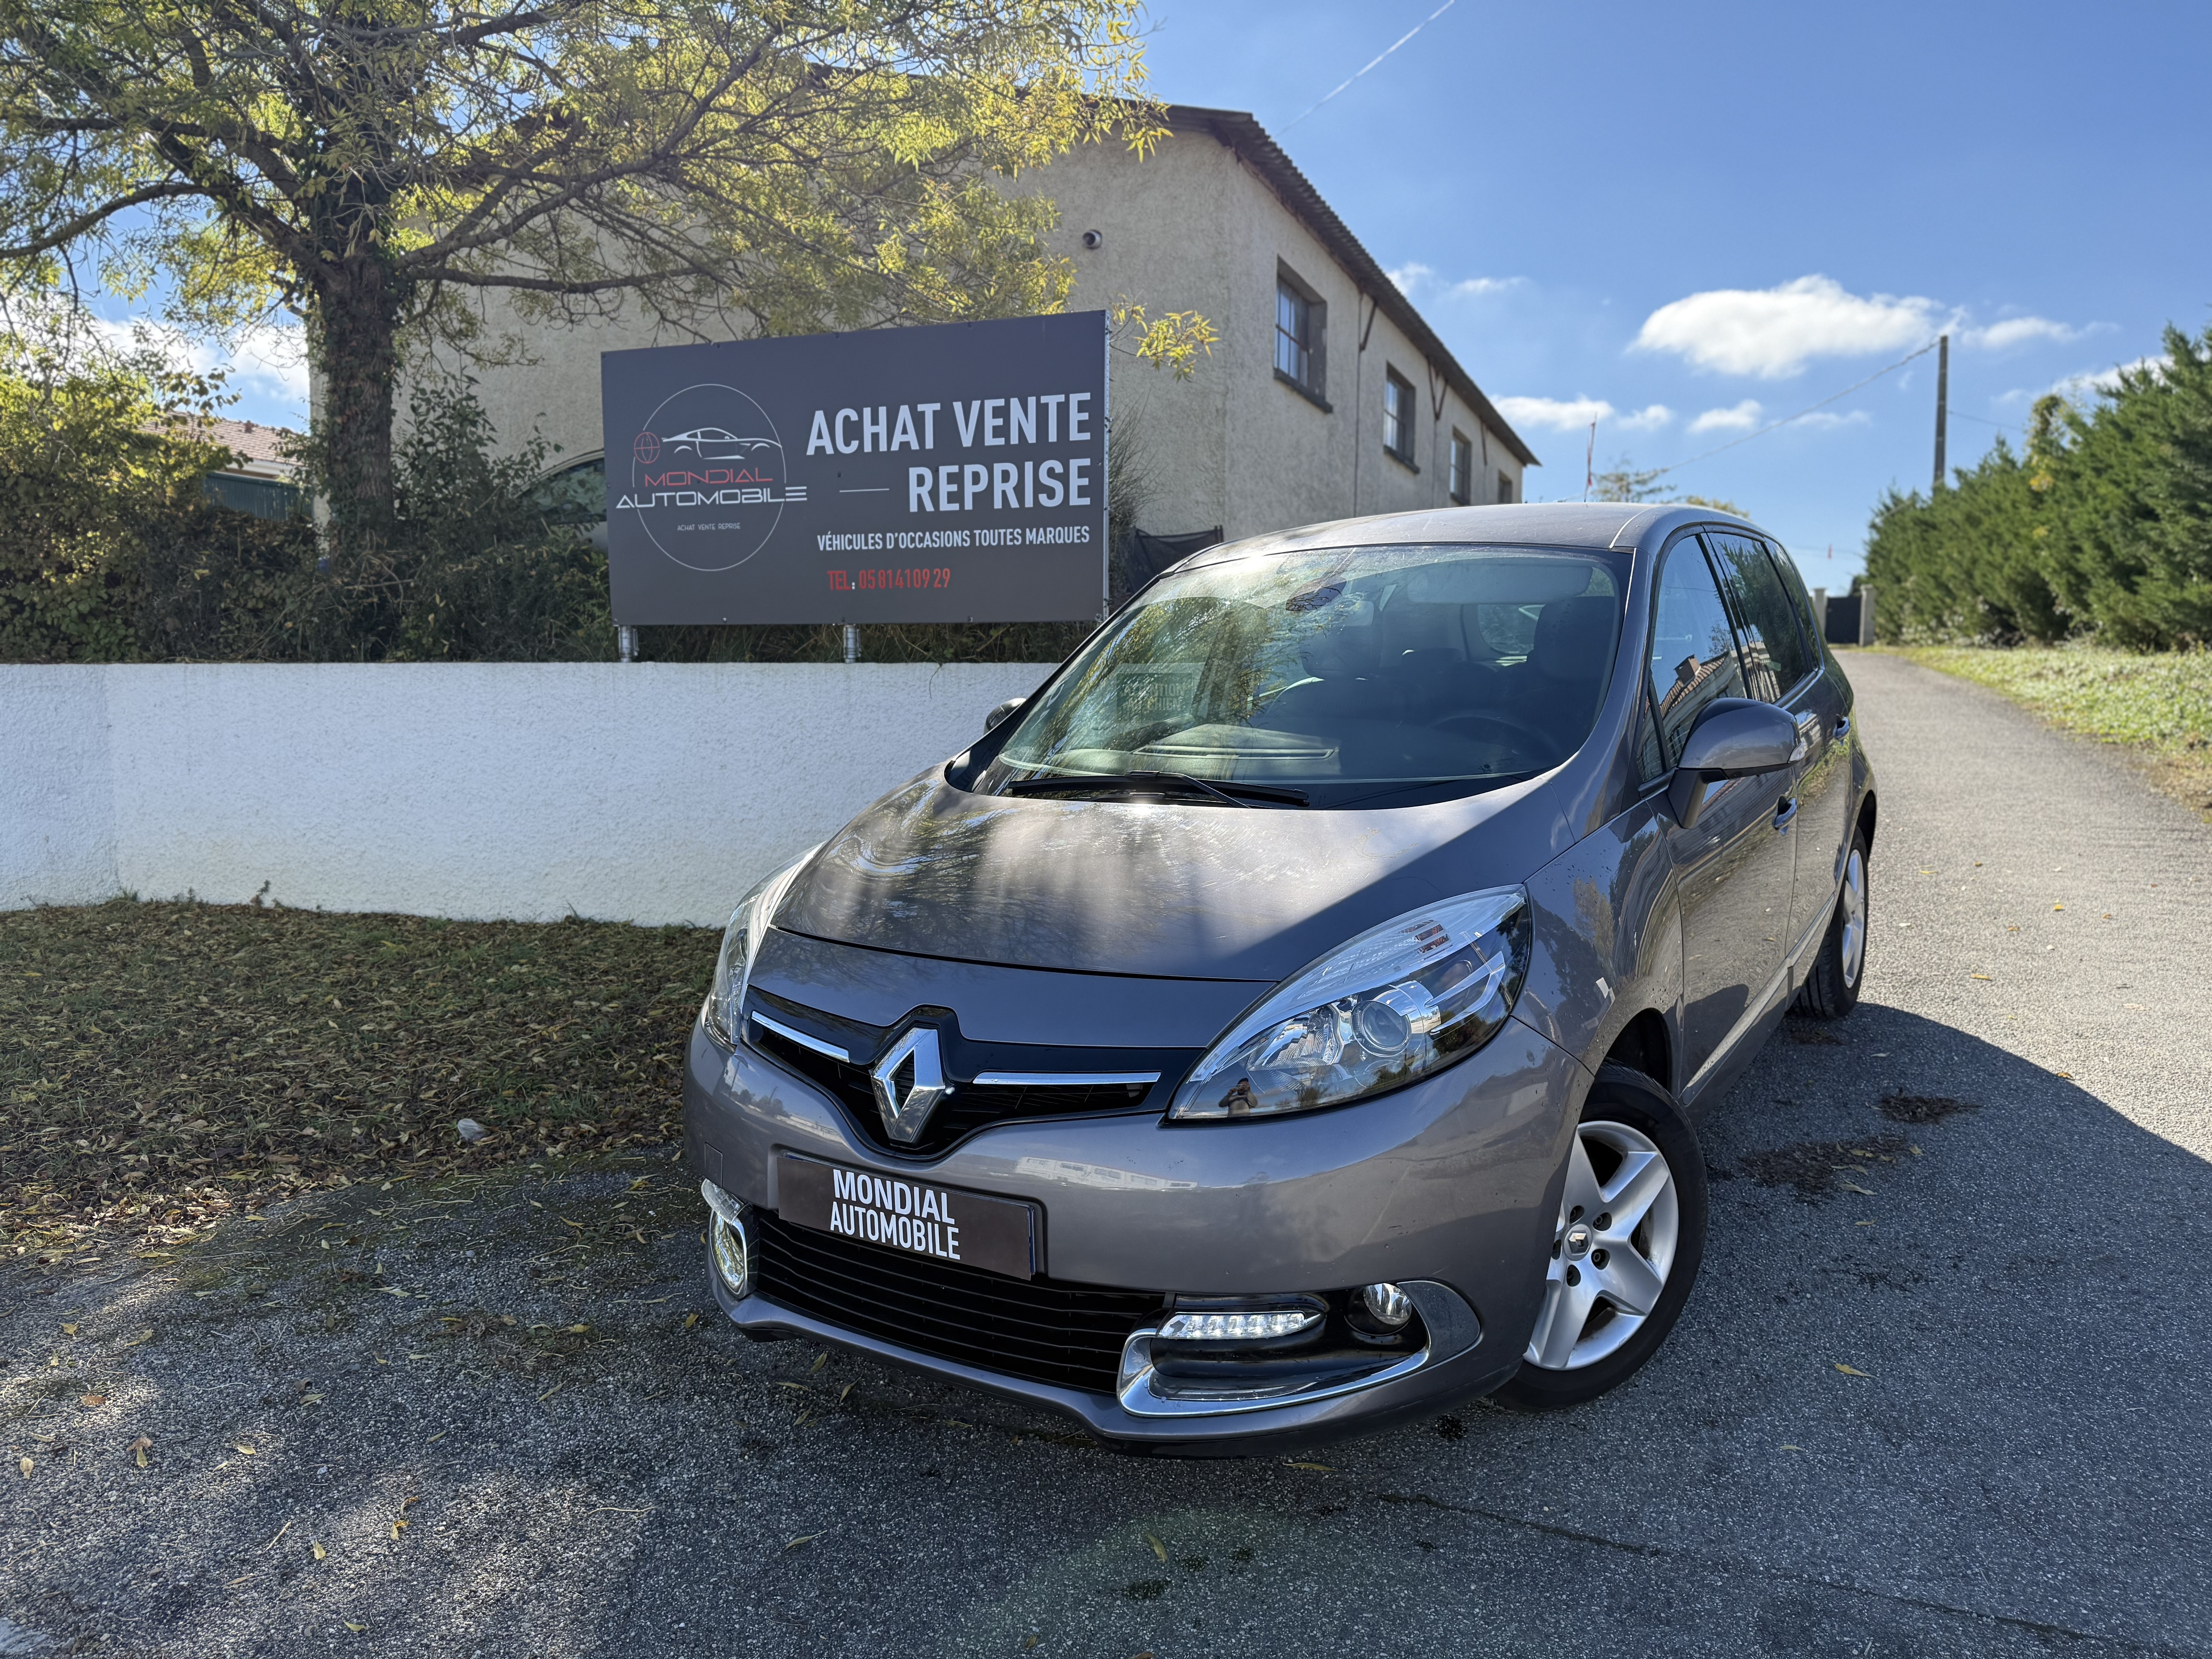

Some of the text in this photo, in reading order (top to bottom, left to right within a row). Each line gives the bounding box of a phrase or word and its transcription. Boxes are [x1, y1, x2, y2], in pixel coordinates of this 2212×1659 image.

[806, 392, 1091, 455] ACHAT VENTE
[616, 486, 807, 508] AUTOMOBILE
[645, 468, 773, 487] MONDIAL
[909, 458, 1091, 512] REPRISE
[817, 526, 1090, 551] VÉHICULES D'OCCASIONS TOUTES MARQUES
[827, 570, 855, 590] TEL:
[833, 1169, 955, 1225] MONDIAL
[830, 1201, 961, 1260] AUTOMOBILE
